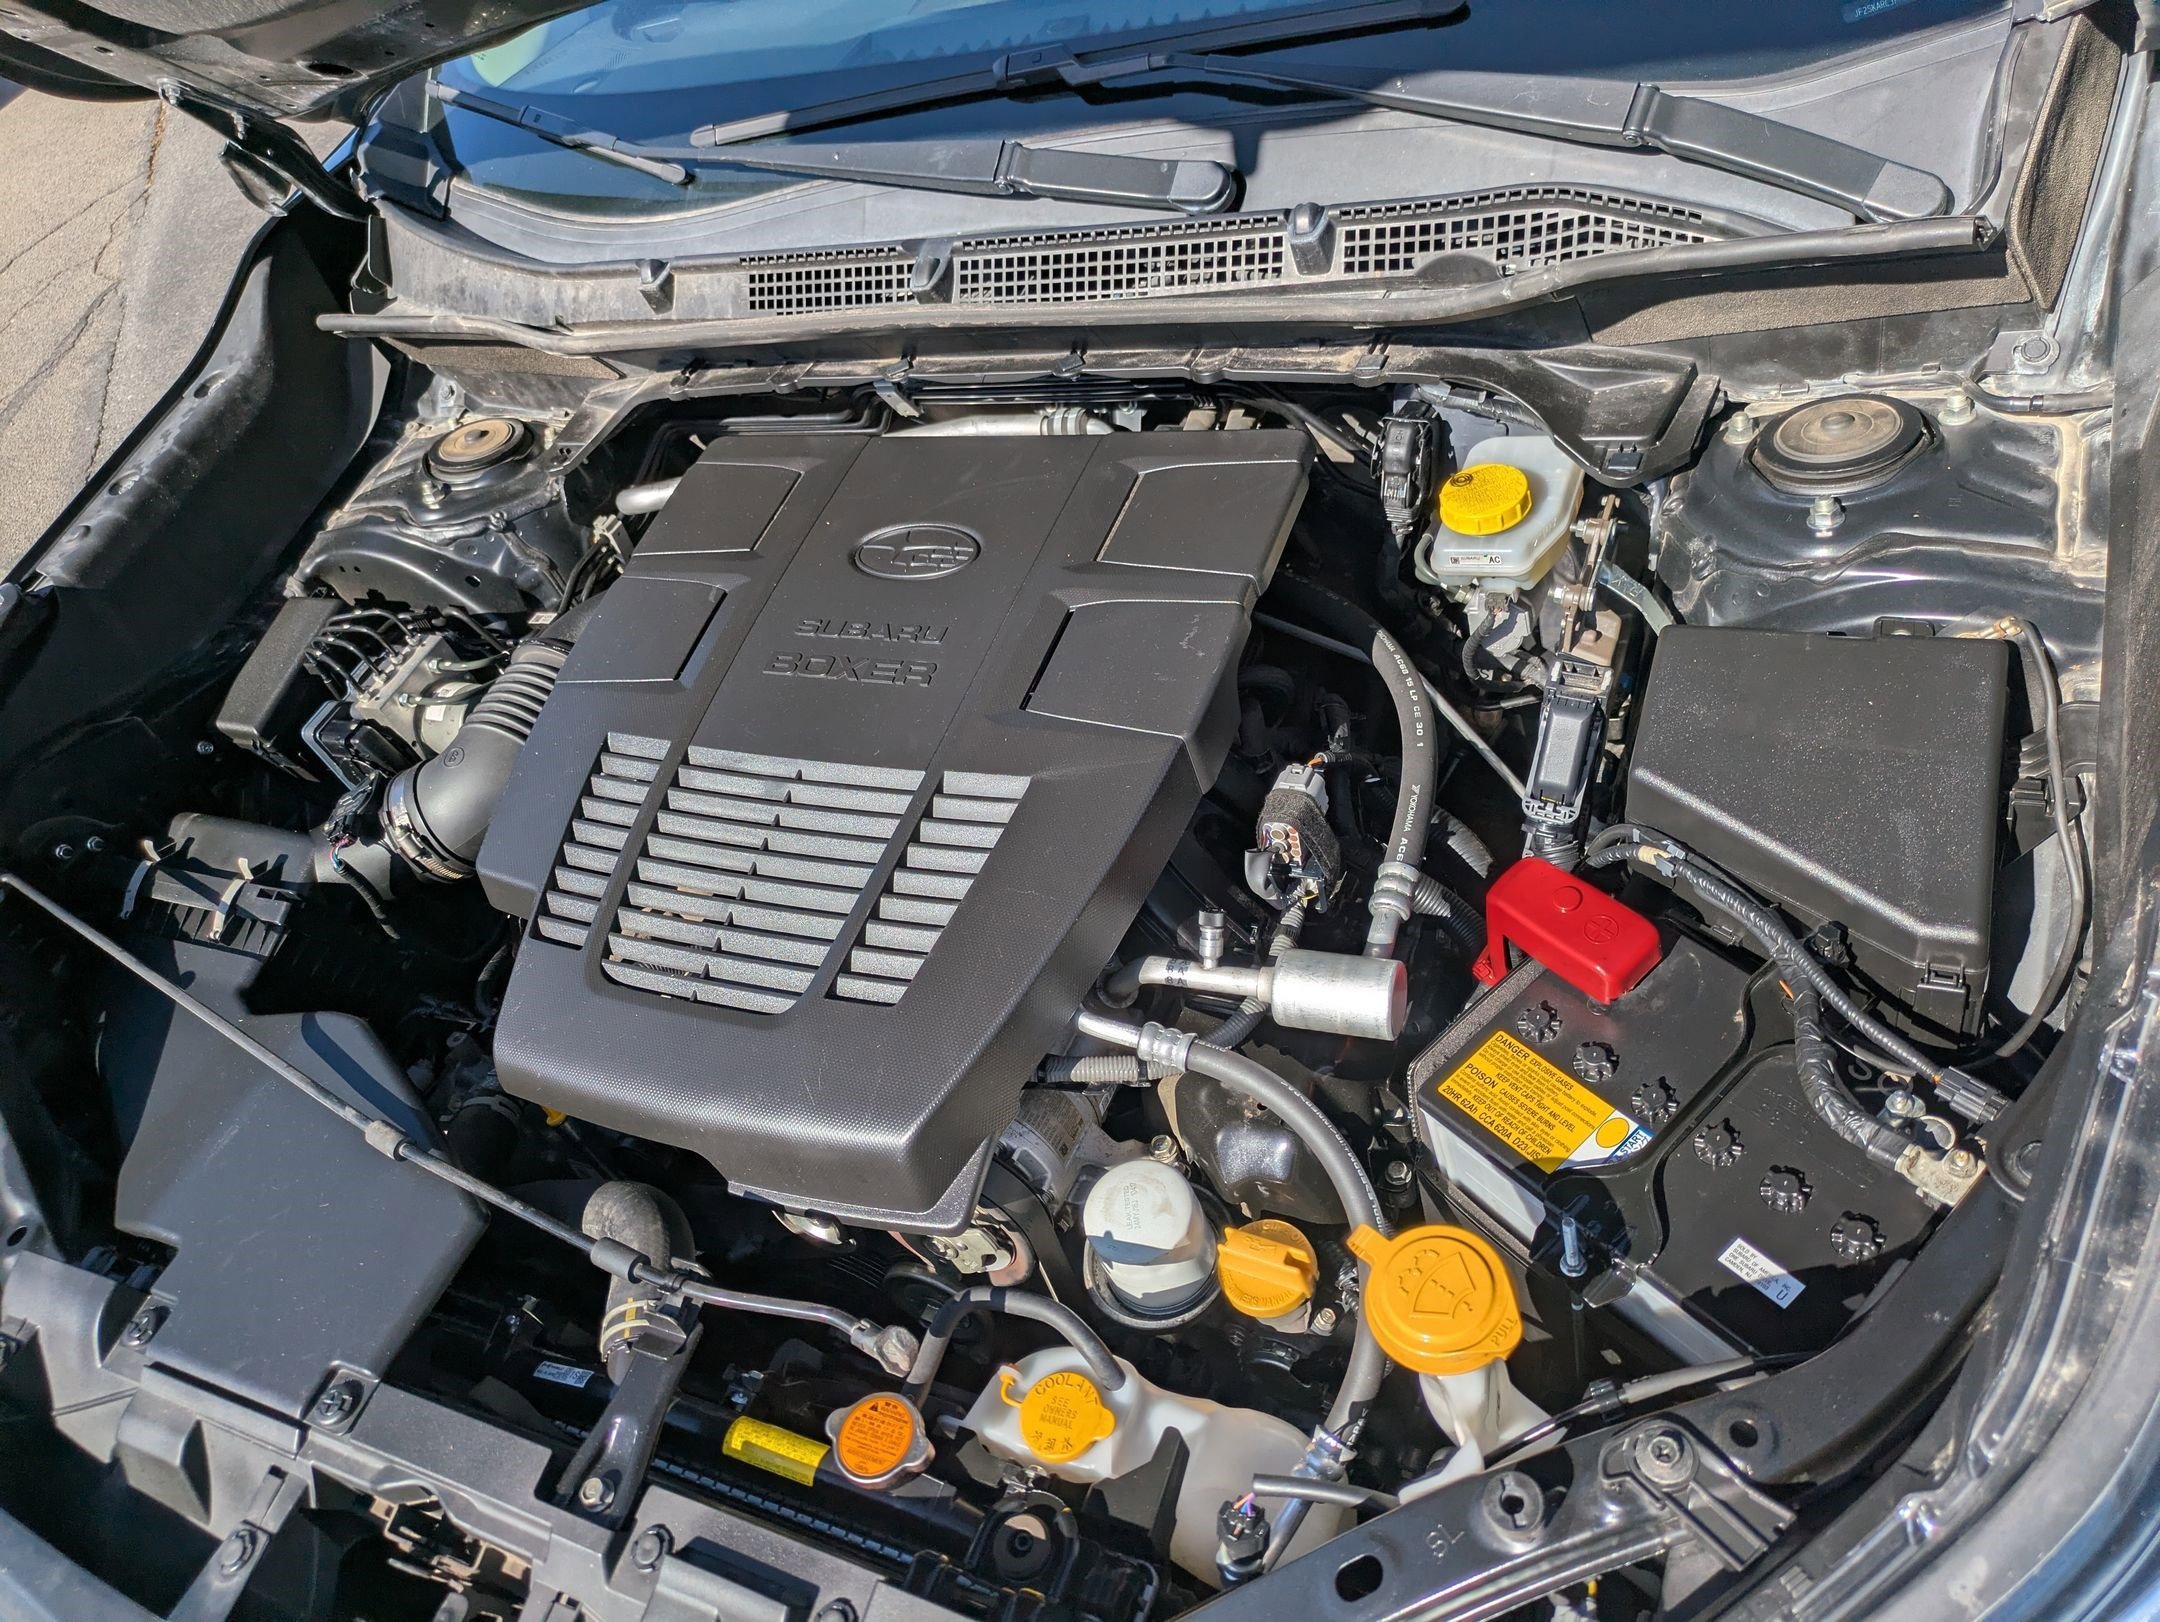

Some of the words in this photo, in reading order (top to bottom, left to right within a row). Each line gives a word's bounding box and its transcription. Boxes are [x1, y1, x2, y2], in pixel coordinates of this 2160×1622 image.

[1489, 556, 1501, 564] AC
[794, 618, 950, 645] SUBARU
[762, 652, 939, 688] BOXER
[1410, 690, 1418, 701] LP
[1414, 706, 1421, 718] CE
[1416, 722, 1424, 736] 30
[1404, 795, 1418, 832] YOKOHAMA
[1495, 1034, 1529, 1060] DANGER
[1528, 1057, 1557, 1079] EXPLOSIVE
[1554, 1075, 1573, 1090] GASES
[1464, 1062, 1498, 1089] POISON
[1498, 1087, 1520, 1104] CAUSES
[1516, 1101, 1539, 1118] SEVERE
[1536, 1115, 1556, 1130] BURNS
[1494, 1072, 1510, 1084] KEEP
[1507, 1081, 1523, 1093] VENT
[1520, 1090, 1536, 1103] CAPS
[1533, 1100, 1550, 1113] TIGHT
[1547, 1109, 1560, 1120] AND
[1558, 1117, 1576, 1132] LEVEL
[1441, 1084, 1462, 1101] 20HR
[1459, 1097, 1479, 1114] 62Ah
[1478, 1111, 1496, 1126] CCA
[1493, 1122, 1513, 1138] 620A
[1471, 1094, 1486, 1106] KEEP
[1483, 1103, 1496, 1113] OUT
[1493, 1110, 1504, 1119] OF
[1500, 1116, 1520, 1131] REACH
[1517, 1128, 1527, 1137] OF
[1524, 1134, 1552, 1154] CHILDREN
[1620, 1131, 1644, 1154] START
[1733, 1248, 1752, 1262] SUBARU
[1737, 1244, 1750, 1254] SOLD
[1739, 1260, 1757, 1274] SUBARU
[1491, 1318, 1518, 1347] PULL
[1035, 1374, 1098, 1406] COOLANT
[1051, 1396, 1070, 1406] SEE
[1040, 1413, 1074, 1430] MANUAL
